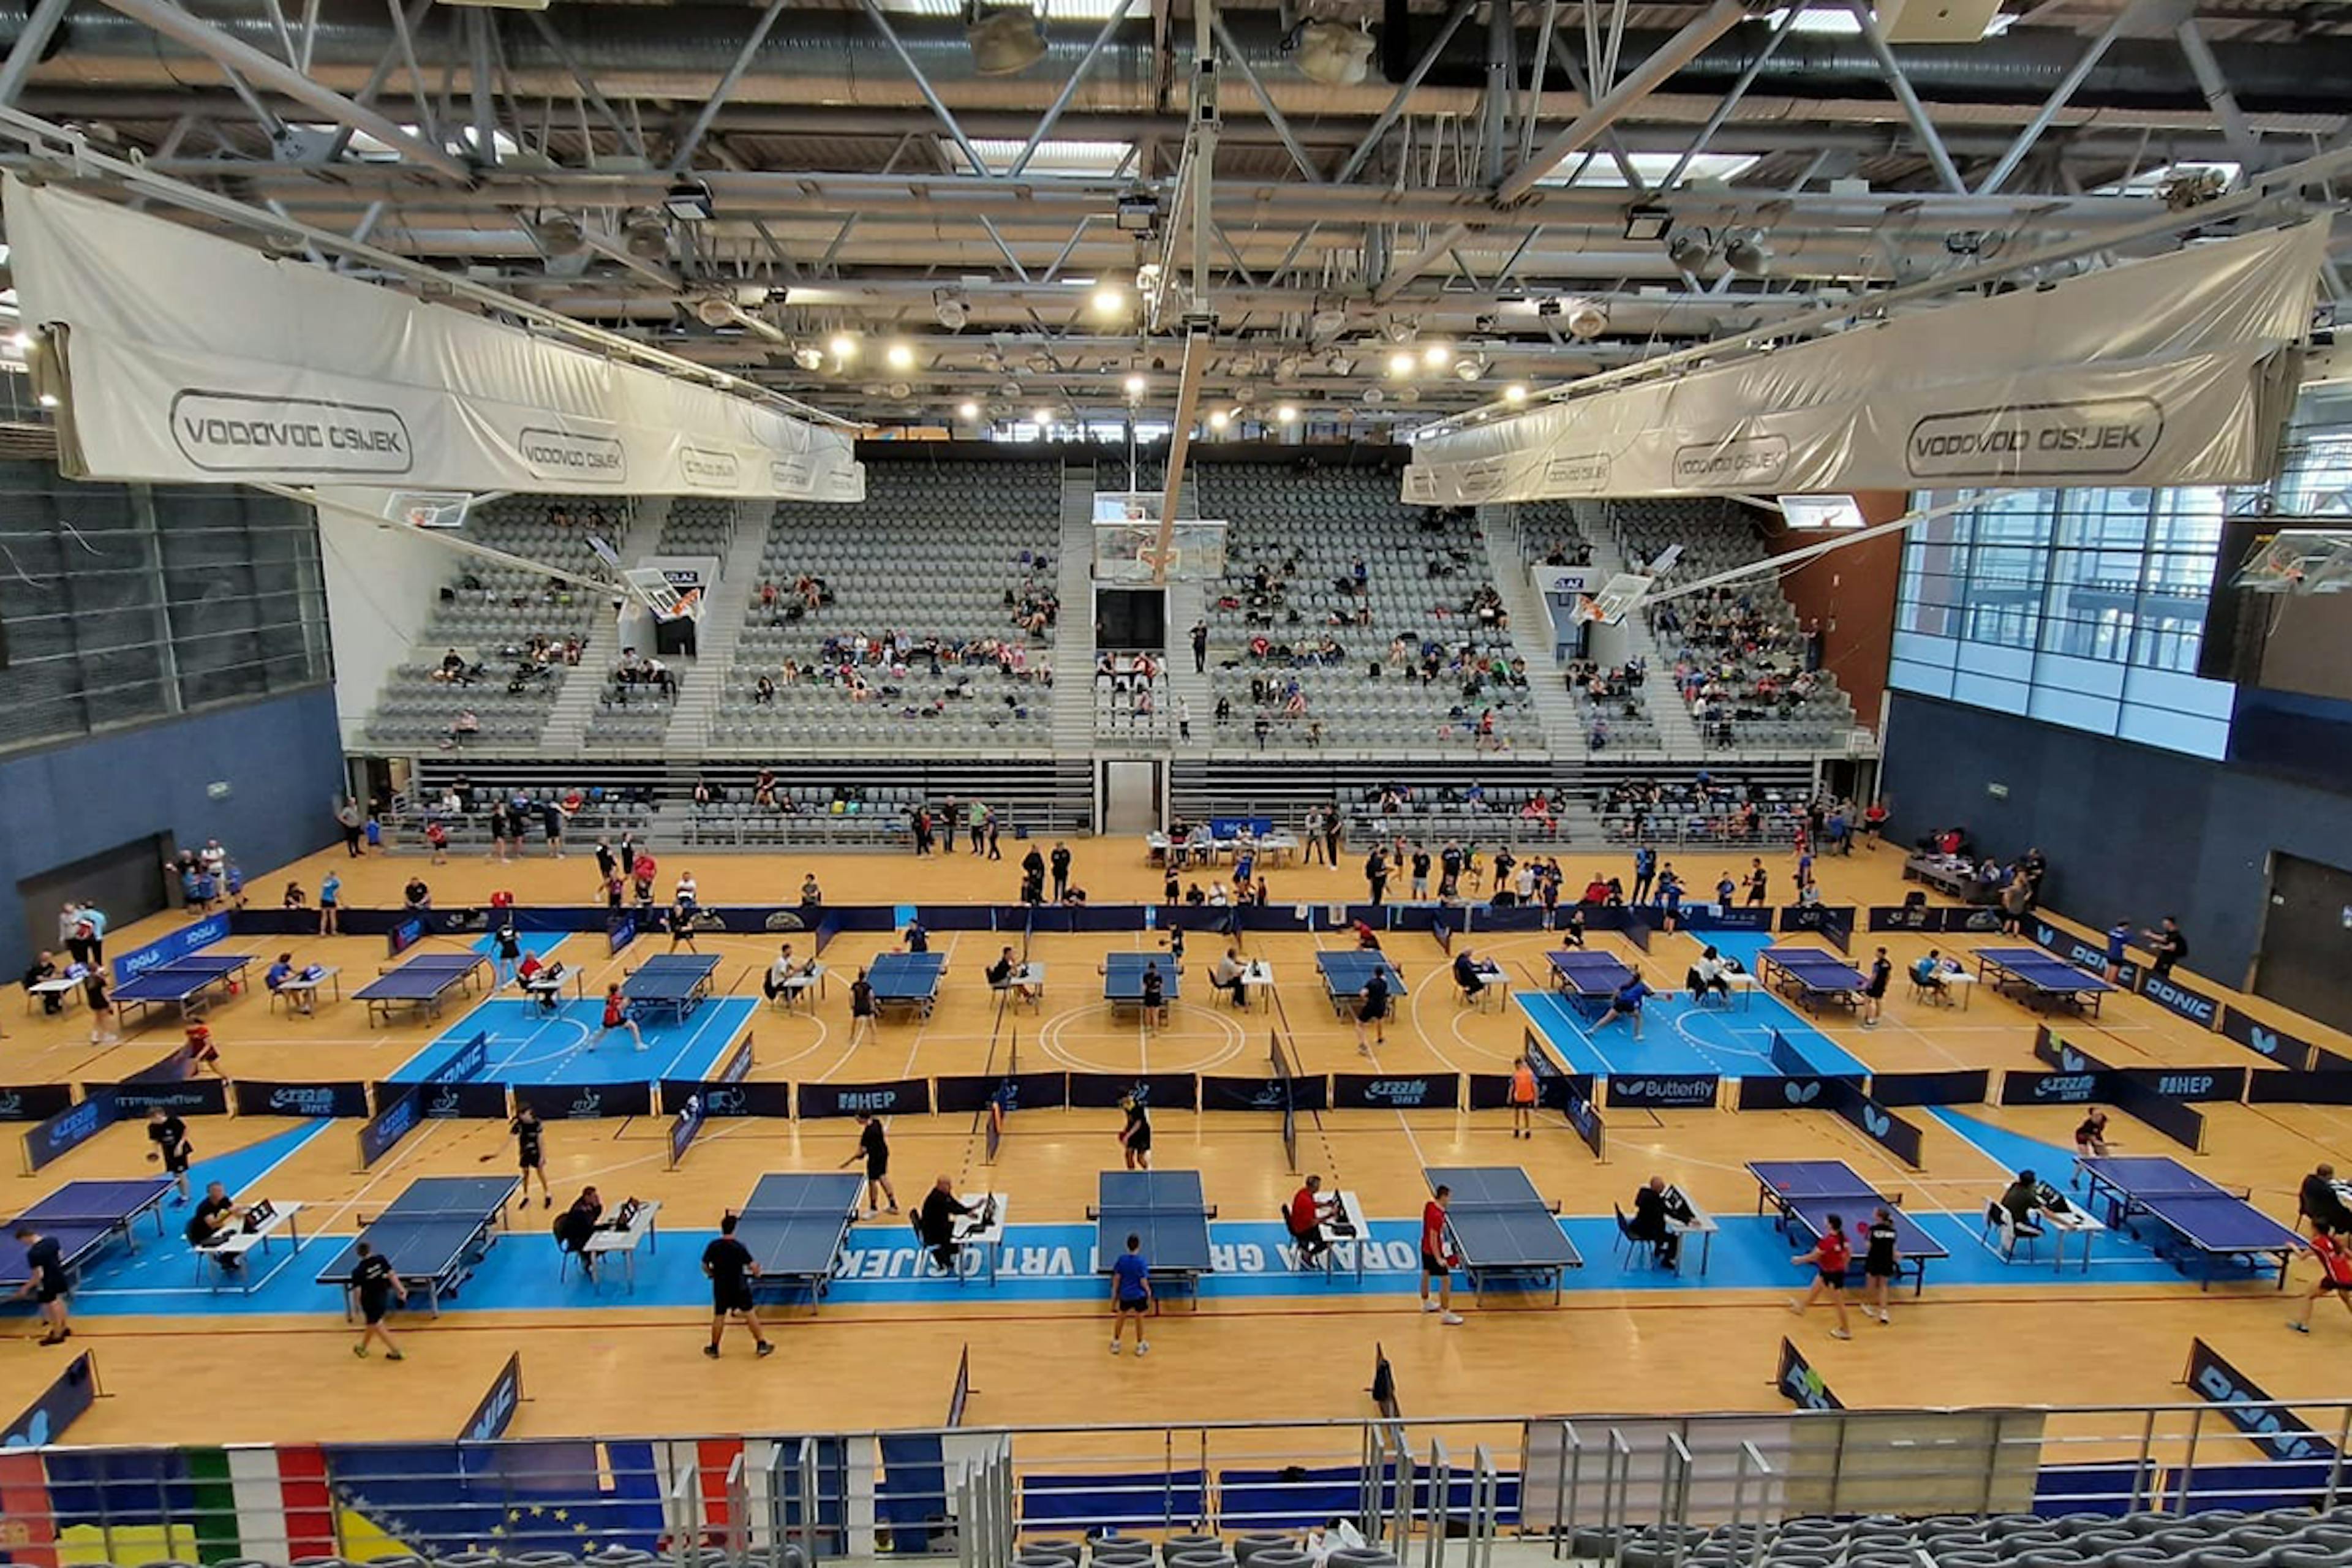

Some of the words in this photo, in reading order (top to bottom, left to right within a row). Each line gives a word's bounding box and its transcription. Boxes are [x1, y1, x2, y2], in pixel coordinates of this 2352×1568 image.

[184, 417, 324, 447] VODOVOD
[329, 427, 404, 453] OSIJEK
[1917, 430, 2029, 457] VODOVOD
[2038, 424, 2141, 450] OSIJEK
[2071, 945, 2134, 981] DONC
[2146, 978, 2212, 1019] DONIC
[1645, 1080, 1714, 1098] Butterfly
[994, 1246, 1074, 1276] VRT
